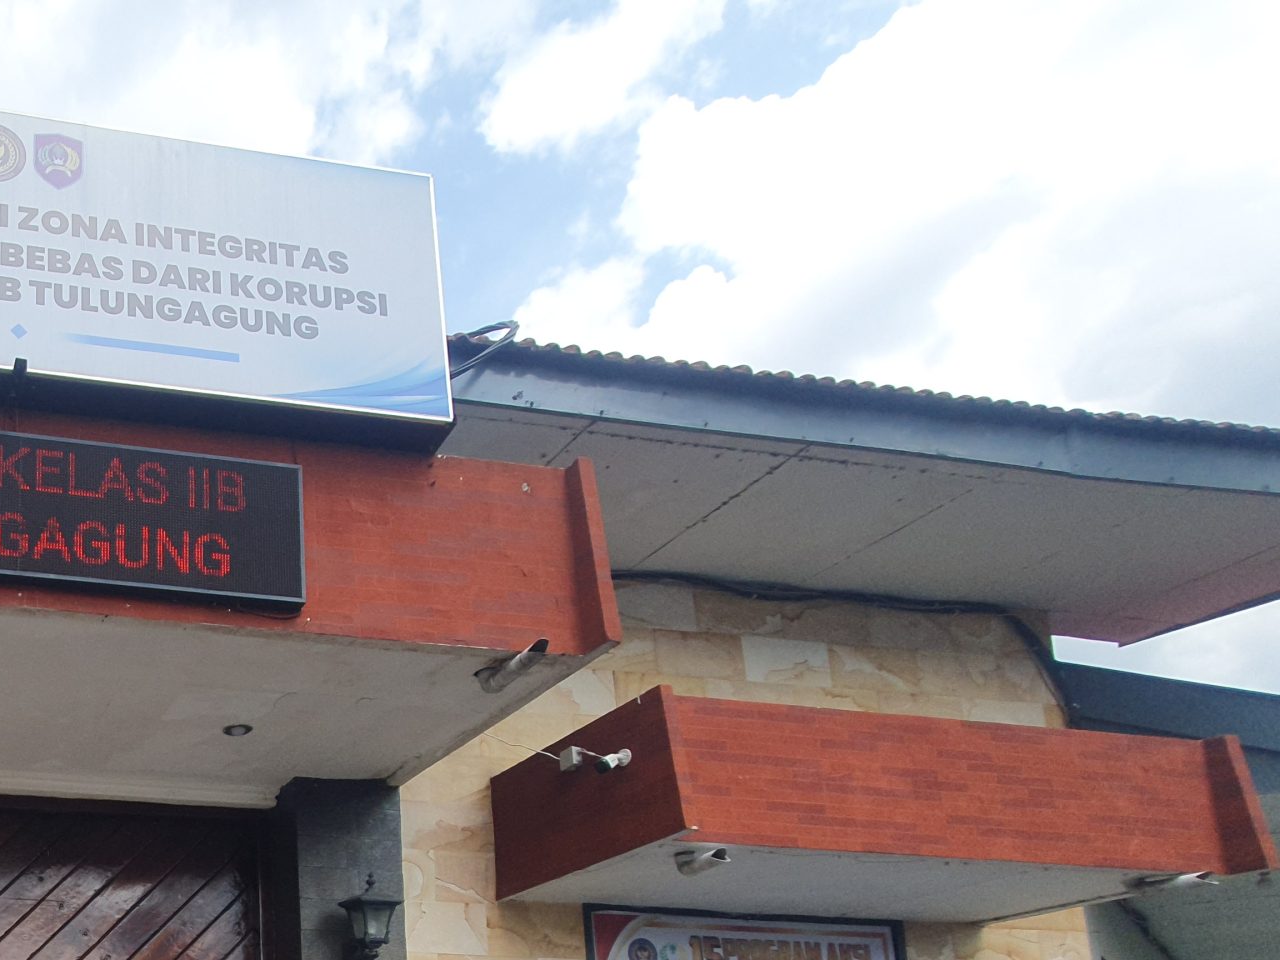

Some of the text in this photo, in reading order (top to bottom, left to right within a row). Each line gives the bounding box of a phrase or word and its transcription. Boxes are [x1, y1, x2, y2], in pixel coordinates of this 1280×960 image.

[18, 206, 127, 244] ZONA
[135, 222, 349, 274] INTEGRITAS
[0, 242, 124, 281] BEBAS
[132, 260, 220, 294] DARI
[229, 273, 388, 317] KORUPSI
[29, 279, 319, 340] TULUNGAGUNG
[188, 466, 246, 512] IIB
